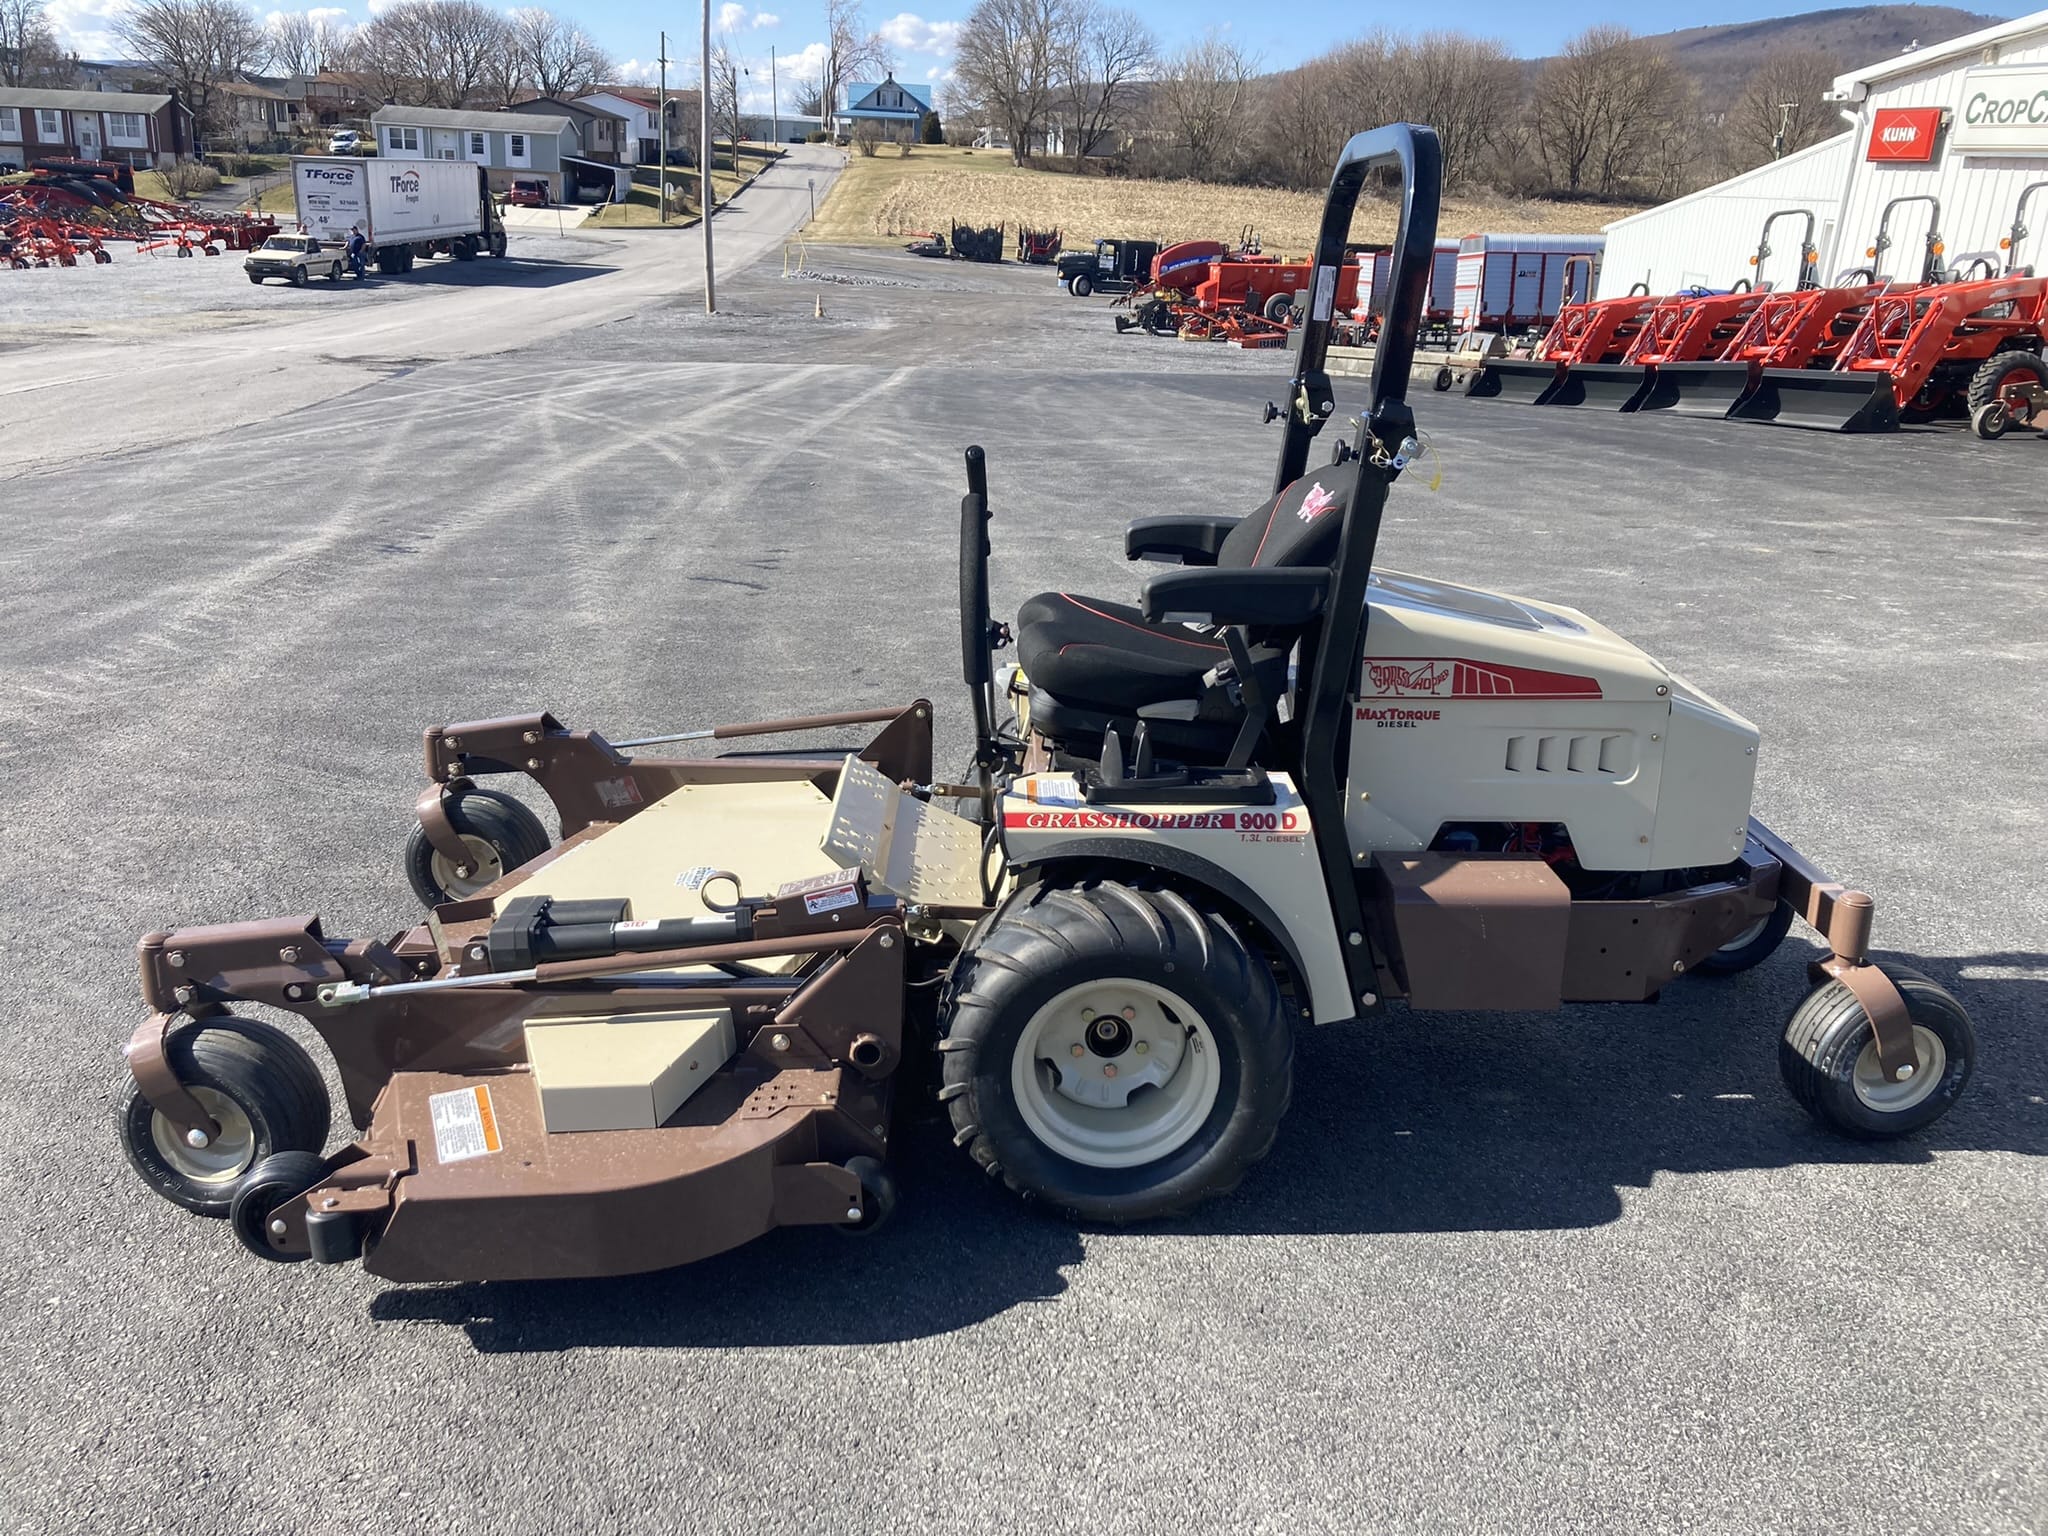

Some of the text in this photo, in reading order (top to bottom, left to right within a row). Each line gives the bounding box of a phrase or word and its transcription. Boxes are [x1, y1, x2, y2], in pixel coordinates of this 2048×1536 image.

[1882, 127, 1917, 142] KUHN
[305, 169, 353, 180] TForce
[390, 176, 419, 192] TForce
[1026, 813, 1297, 829] GRASSHOPPER 900 D
[1241, 834, 1301, 843] 1.3L DIESEL
